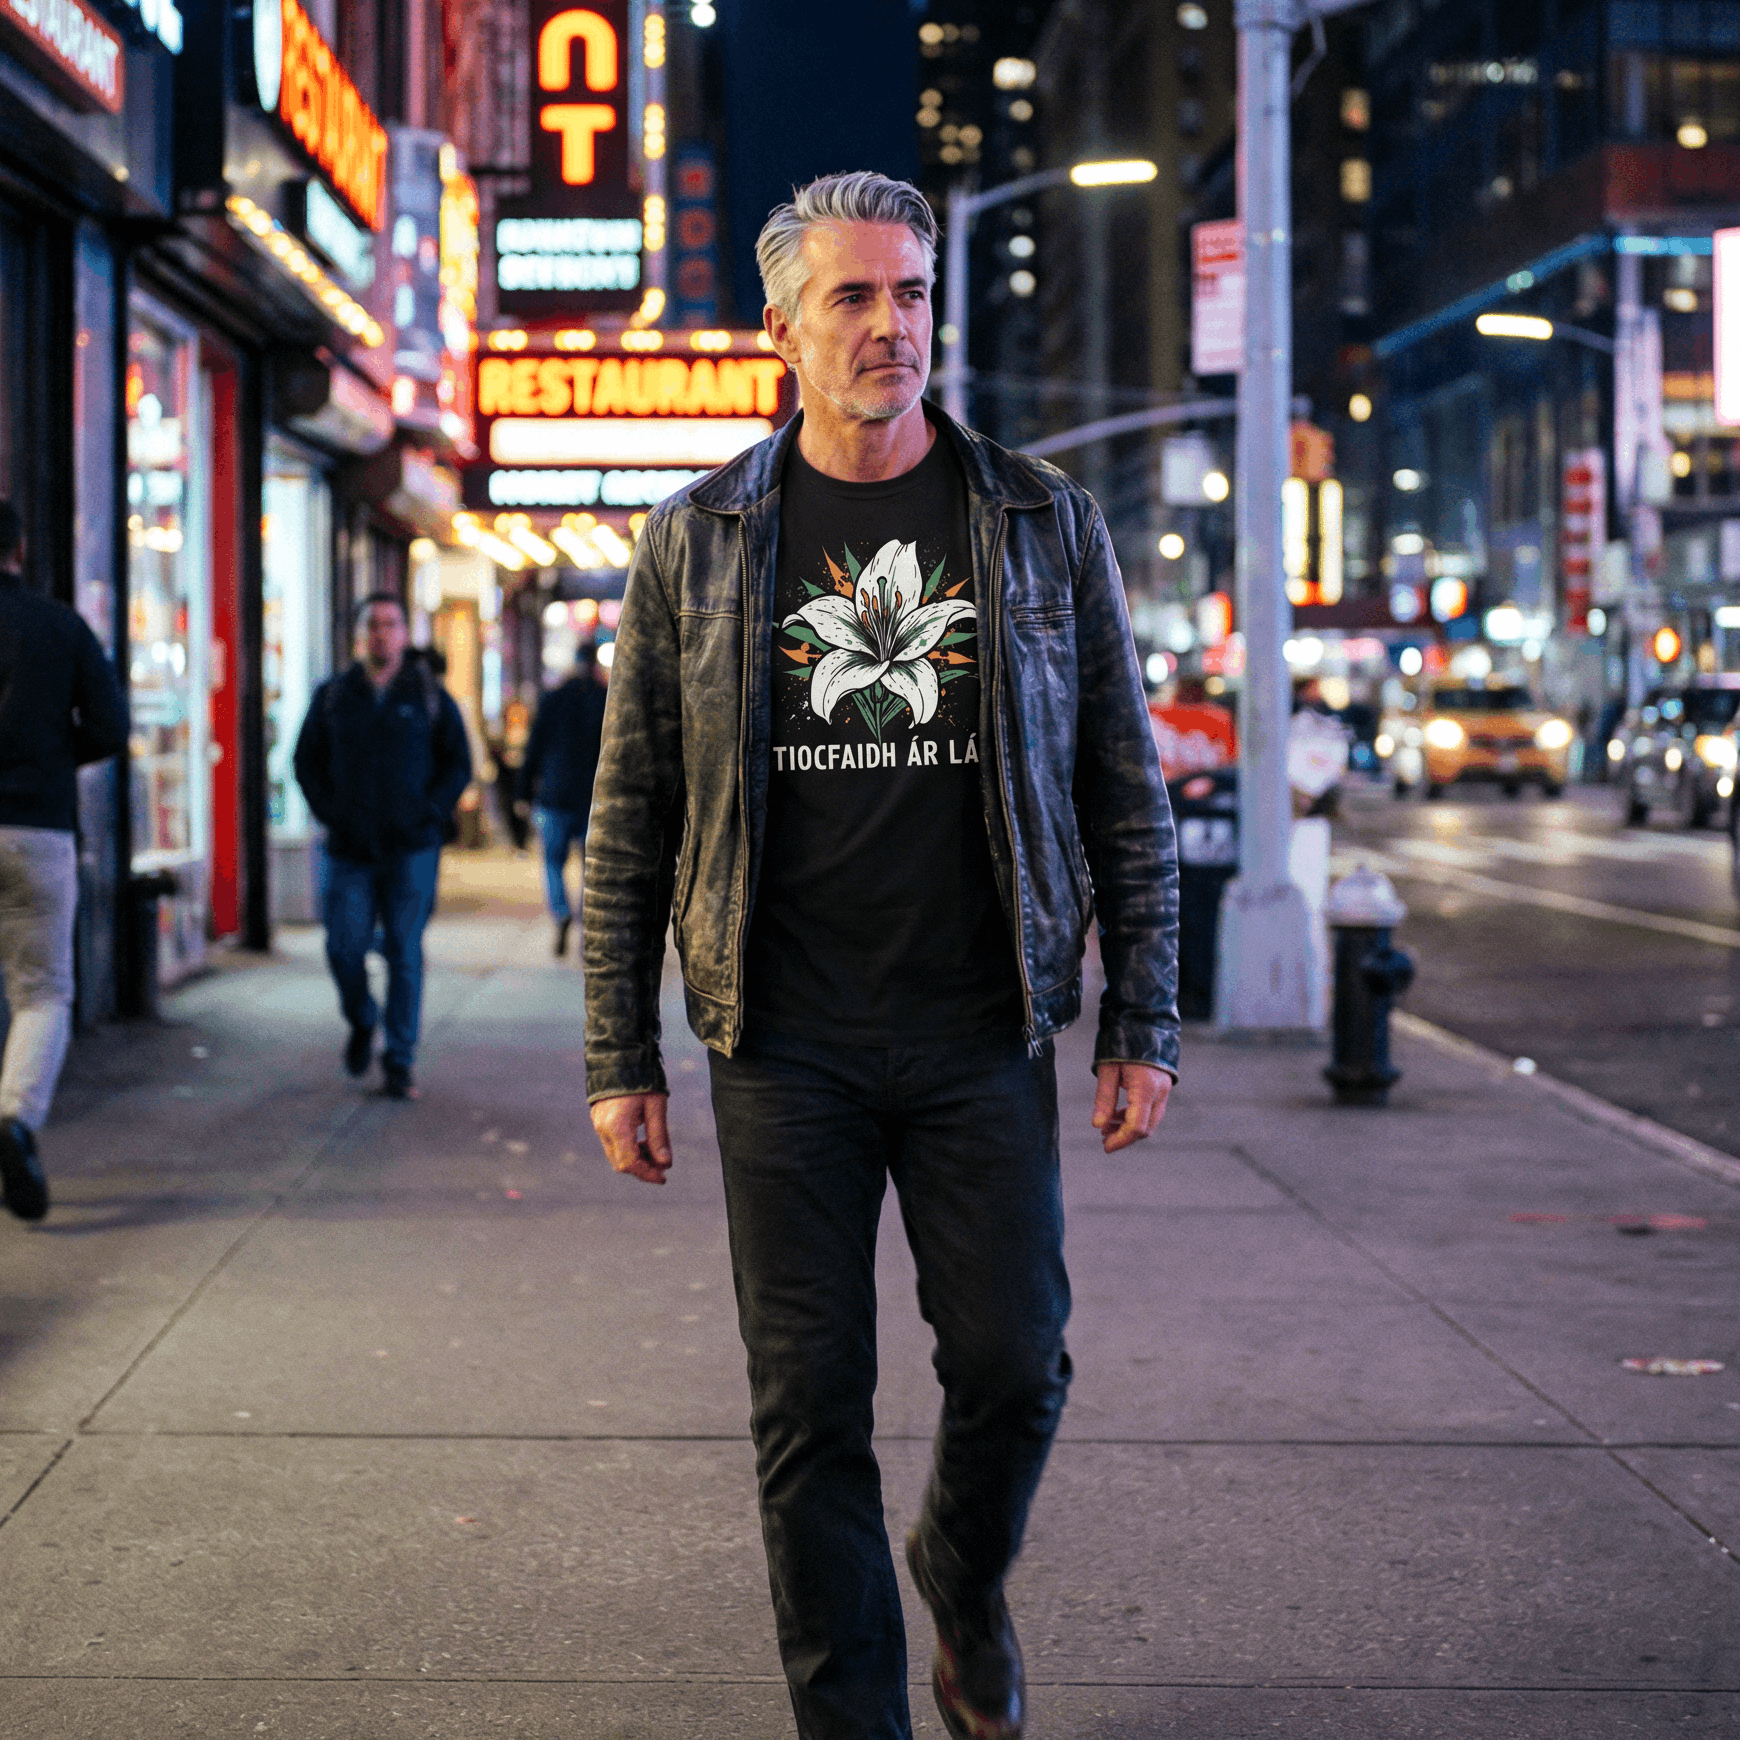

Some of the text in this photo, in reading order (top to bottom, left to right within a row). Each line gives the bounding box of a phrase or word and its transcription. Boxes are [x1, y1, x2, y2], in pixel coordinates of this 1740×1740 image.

[478, 357, 786, 417] RESTAURANT
[773, 732, 979, 771] TIOCFAIDH ÁR LÁ
